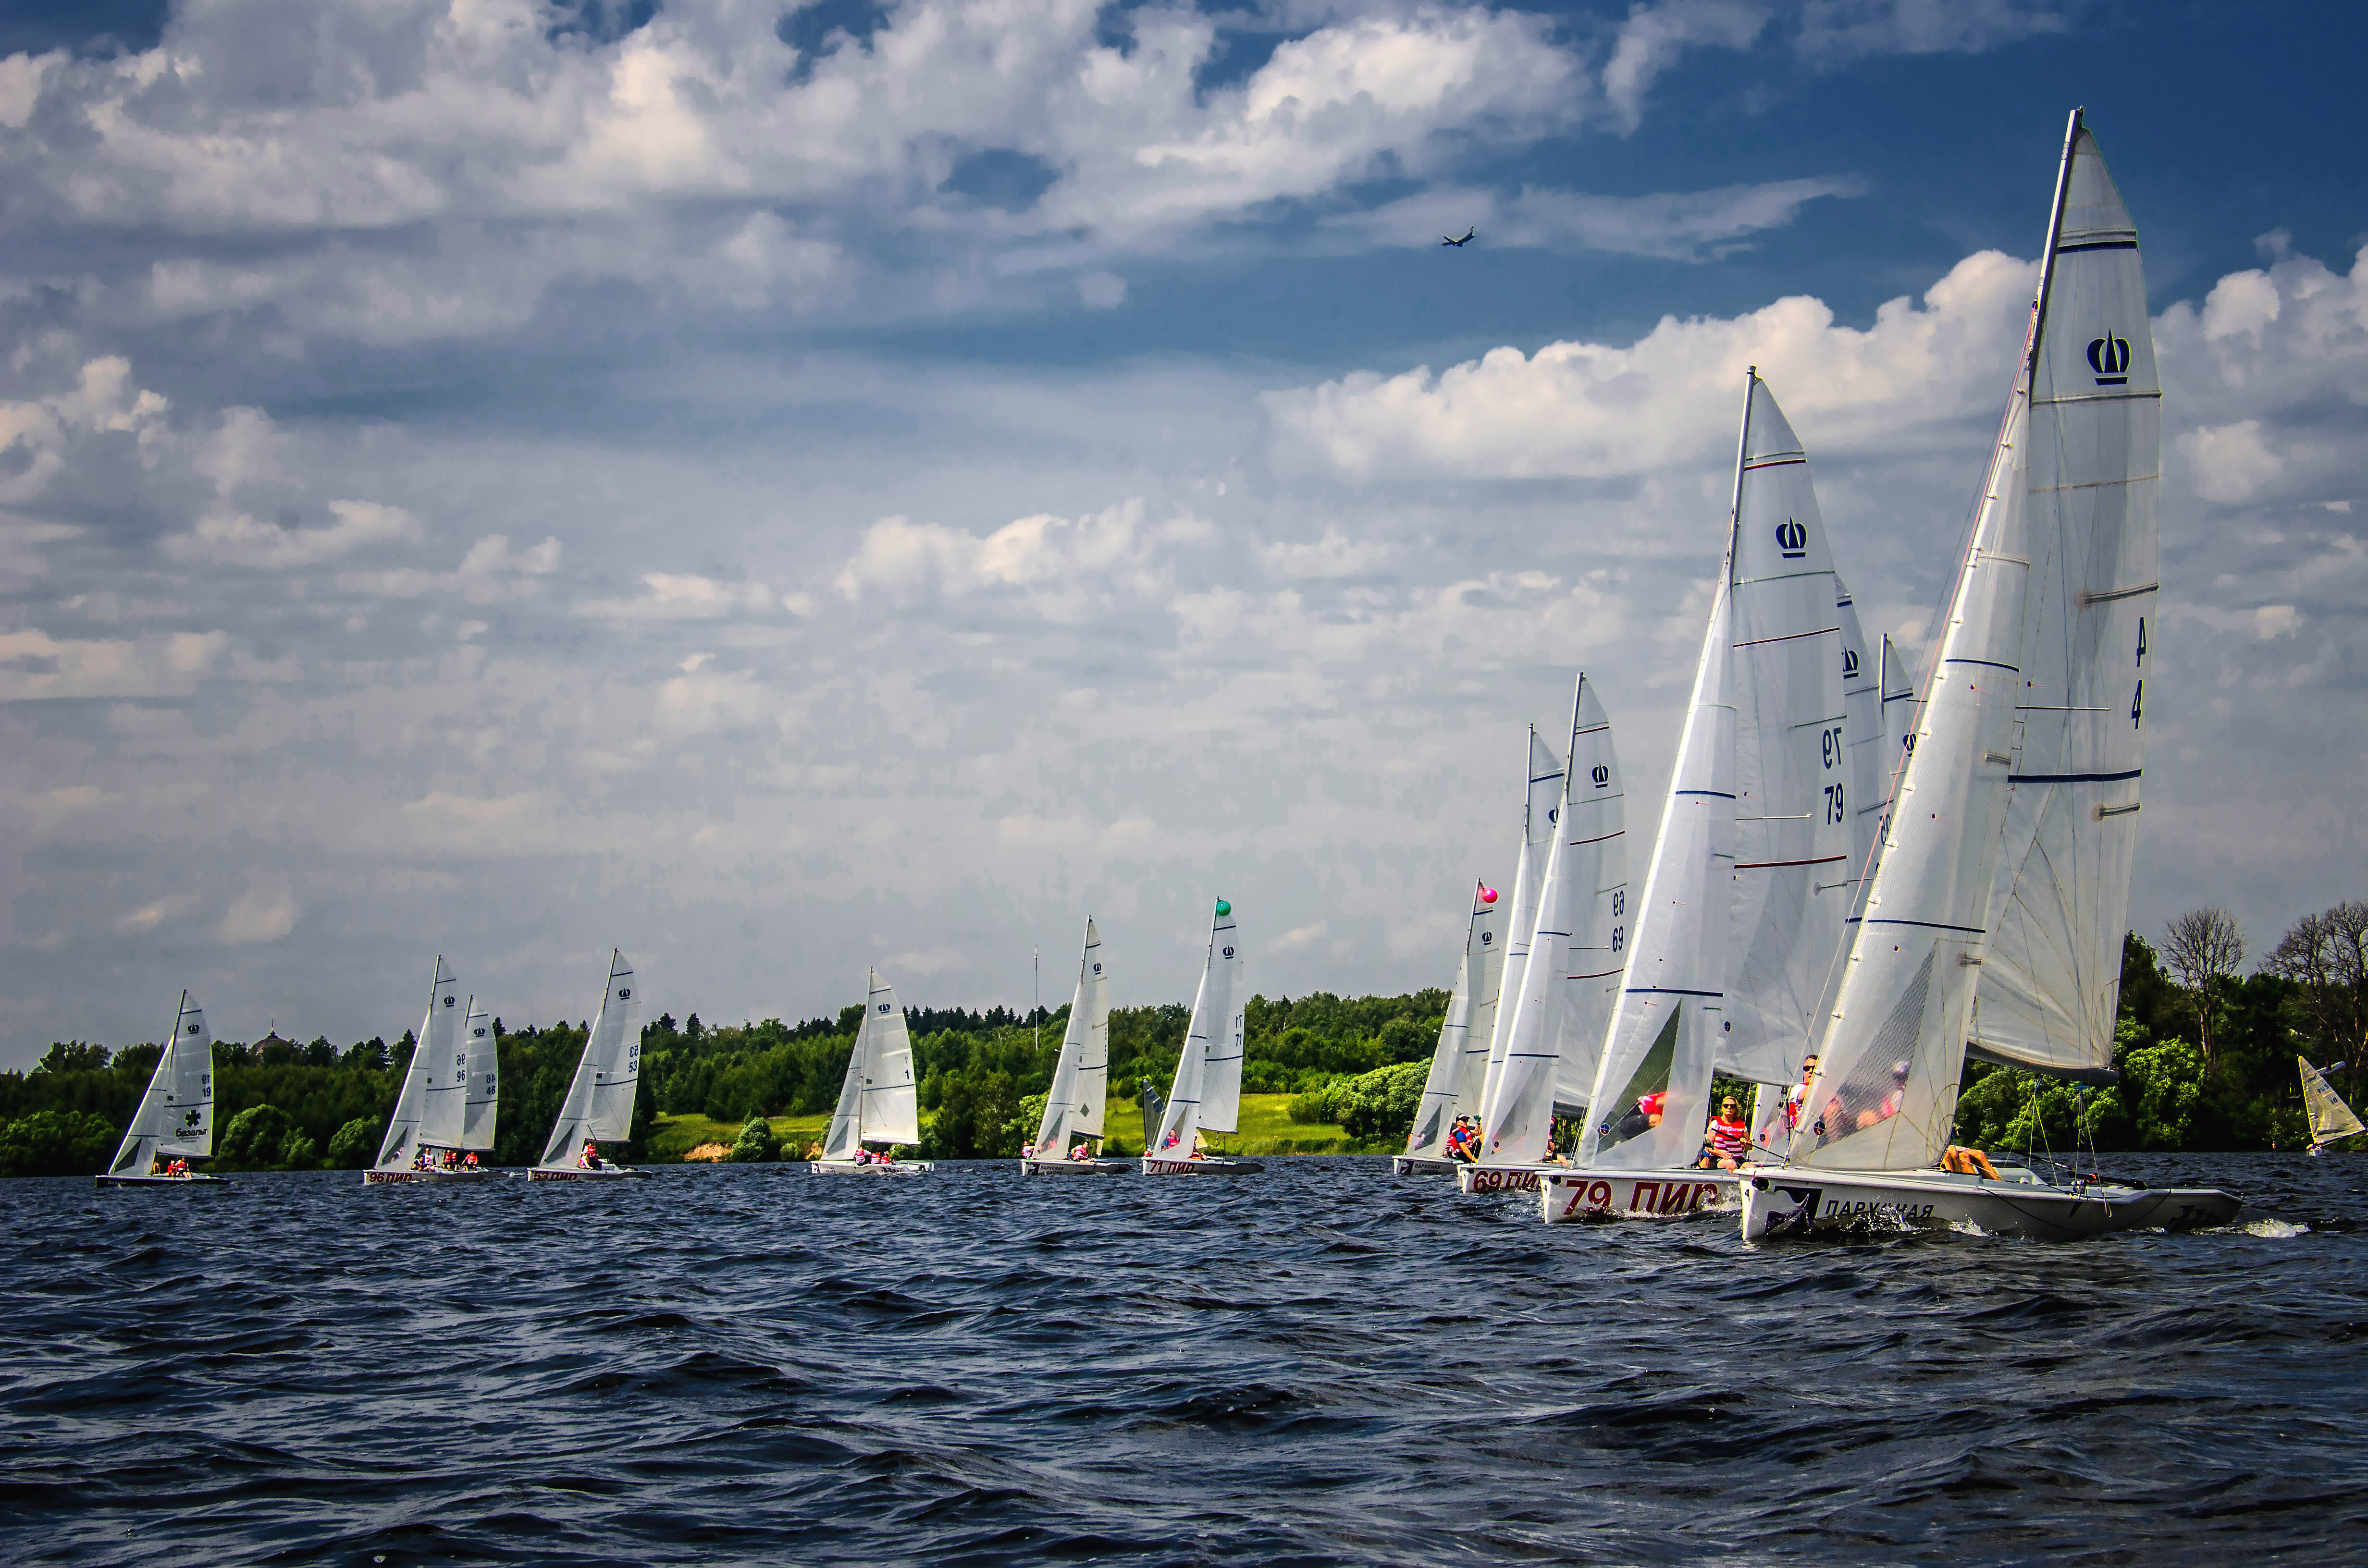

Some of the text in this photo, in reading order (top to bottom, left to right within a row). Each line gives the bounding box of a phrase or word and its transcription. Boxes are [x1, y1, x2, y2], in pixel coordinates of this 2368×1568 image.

[2131, 680, 2143, 729] 4
[1825, 783, 1844, 825] 79
[1613, 926, 1623, 952] 69
[1235, 1033, 1242, 1046] 71
[629, 1060, 637, 1073] 53
[457, 1070, 465, 1082] 96
[905, 1069, 910, 1079] 1
[202, 1087, 211, 1097] 19
[486, 1086, 495, 1095] 46
[2317, 1083, 2329, 1093] RUS
[175, 1128, 208, 1137] базальт
[1150, 1161, 1195, 1174] 71 ПИР
[369, 1172, 384, 1183] 96
[534, 1172, 548, 1181] 53
[1473, 1171, 1541, 1192] 69 ПИ
[1563, 1179, 1718, 1215] 79 ПИР
